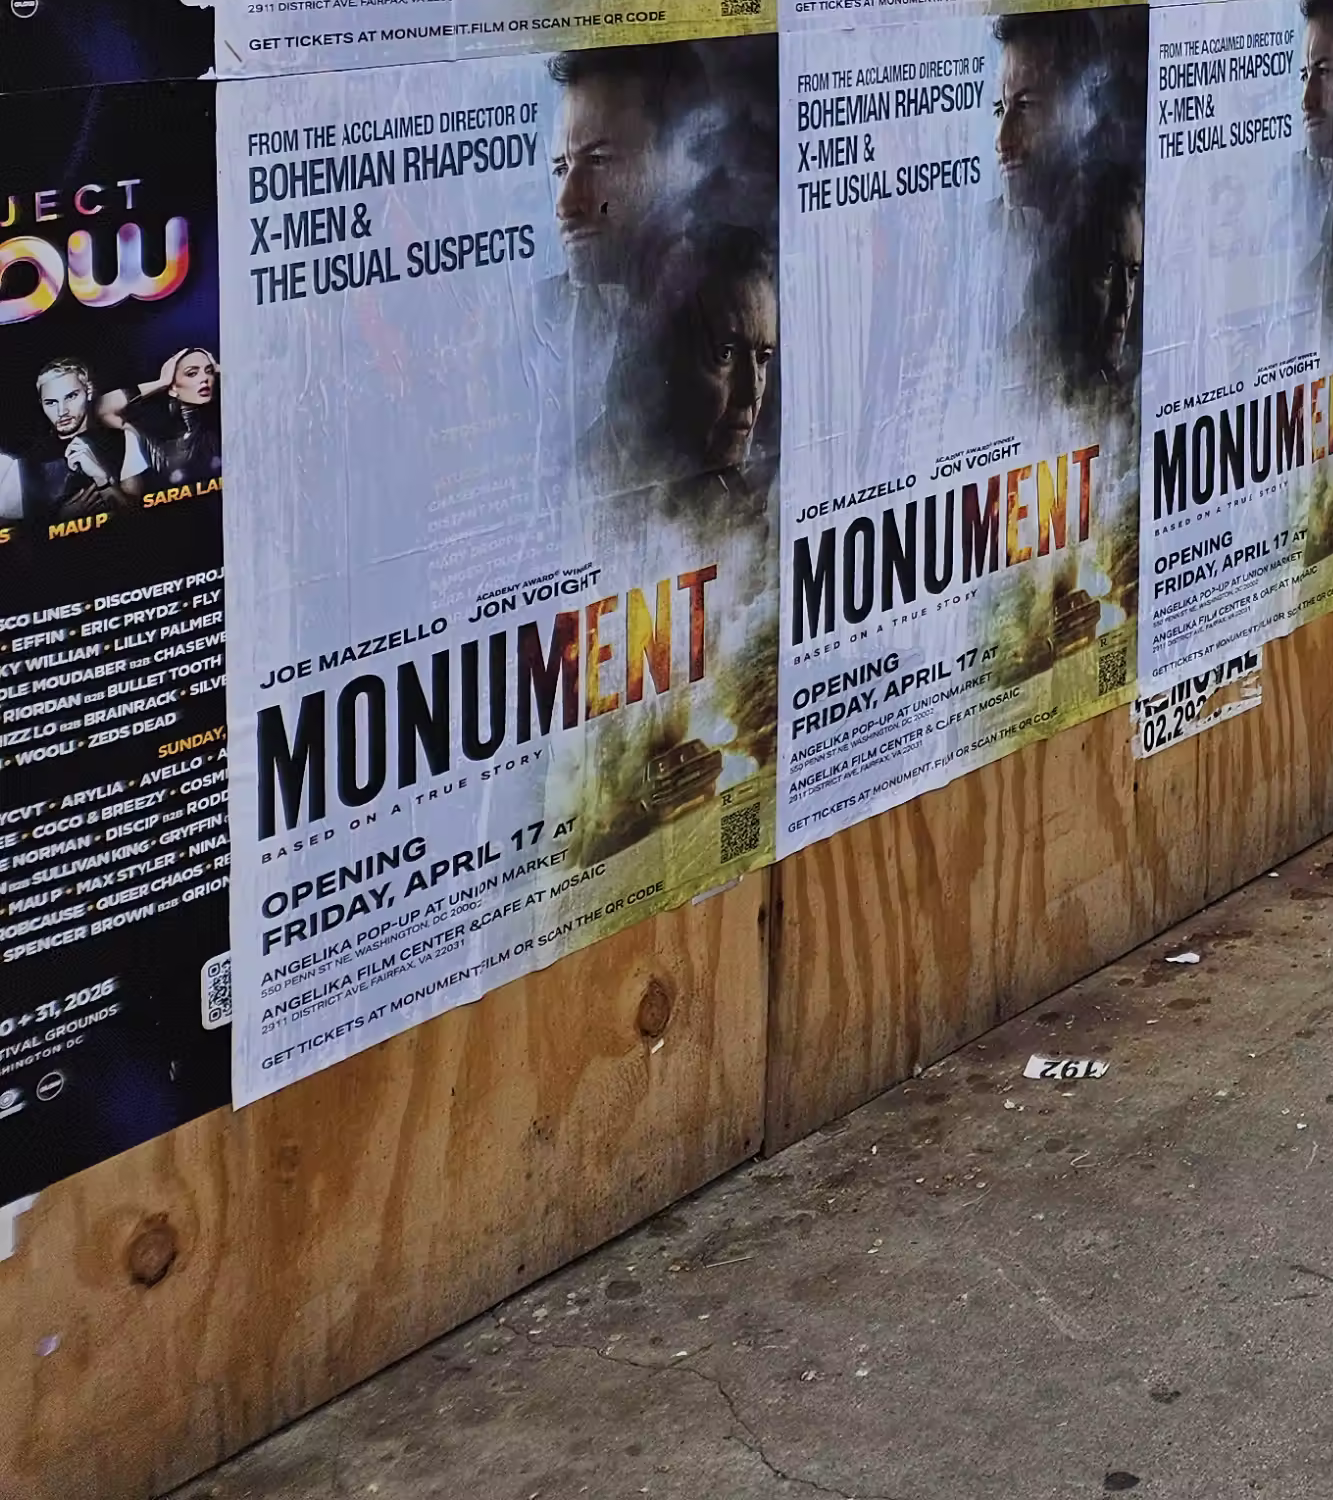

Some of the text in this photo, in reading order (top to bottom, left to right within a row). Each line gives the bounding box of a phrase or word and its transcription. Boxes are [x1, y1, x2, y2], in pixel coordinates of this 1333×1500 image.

[143, 486, 192, 508] SARA
[790, 441, 1098, 647] MONUMENT
[1154, 529, 1232, 577] OPENING
[256, 561, 716, 845] MONUMENT
[790, 650, 900, 713] OPENING
[158, 725, 227, 758] SUNDAY,
[260, 833, 427, 924] OPENING
[261, 820, 544, 961] FRIDAY, APRIL 17
[4, 902, 154, 963] SPENCER BROWN
[64, 978, 117, 1012] 2026
